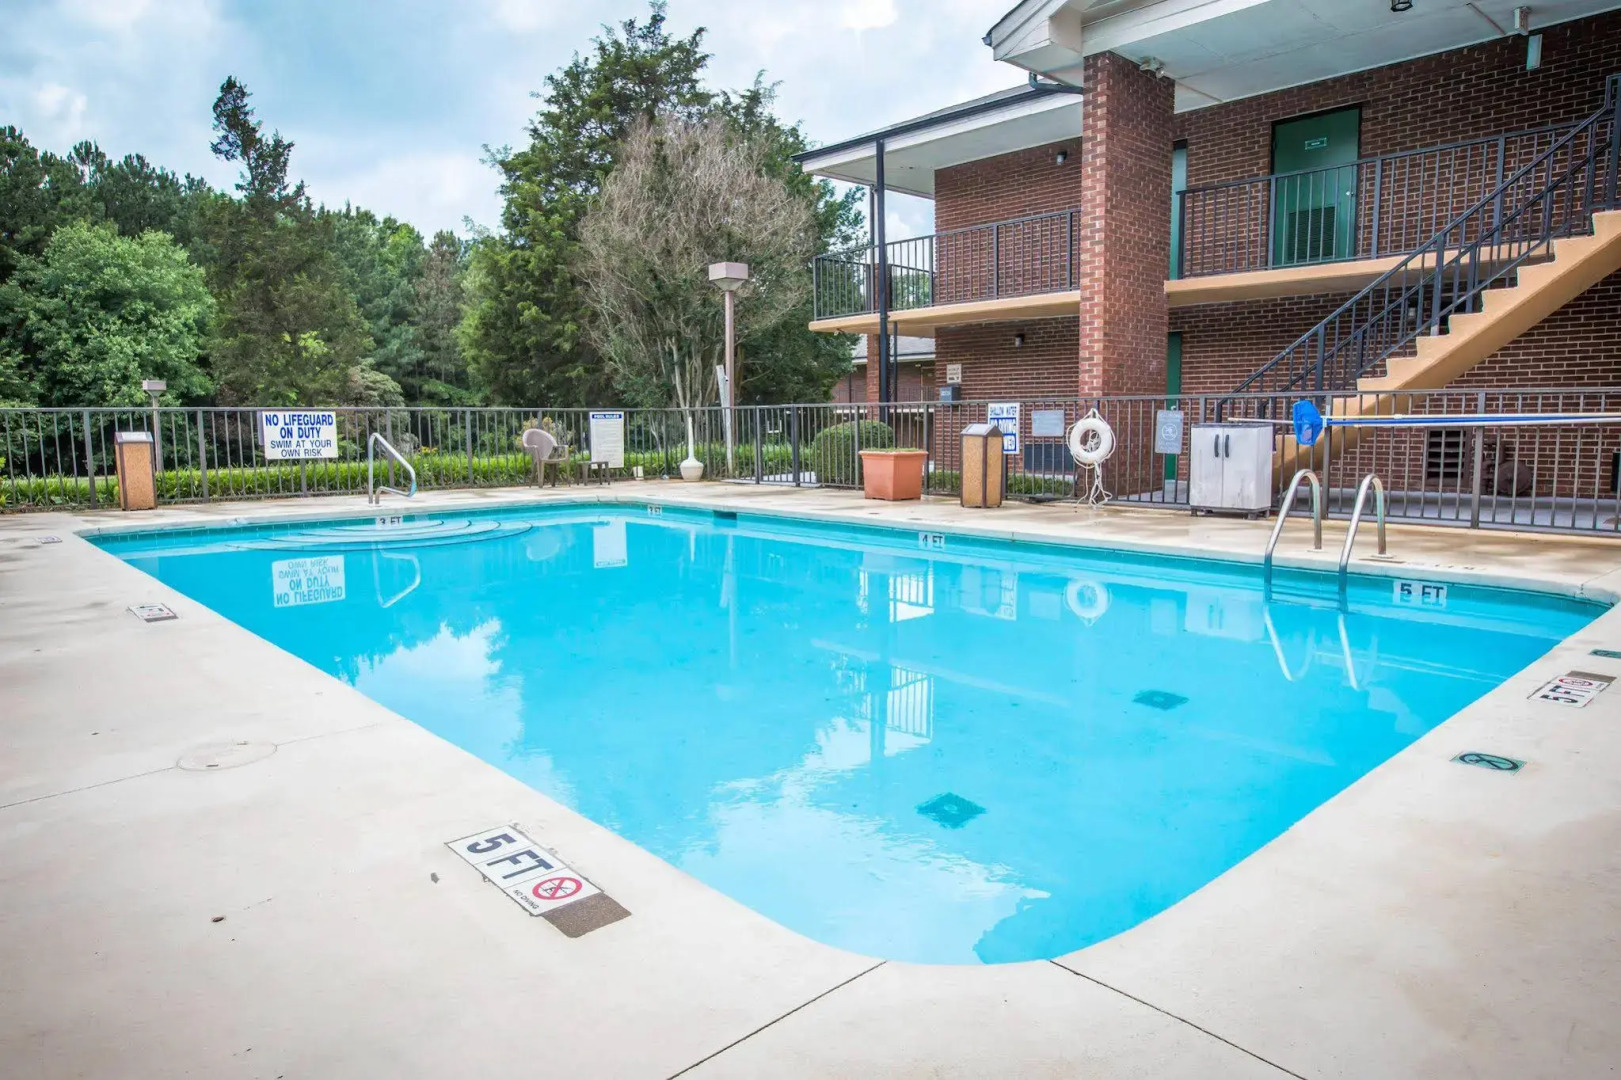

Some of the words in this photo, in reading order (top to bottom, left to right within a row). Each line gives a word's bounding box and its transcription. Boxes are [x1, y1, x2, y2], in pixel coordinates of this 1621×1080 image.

[265, 414, 279, 426] NO
[283, 414, 334, 426] LIFEGUARD
[280, 427, 293, 439] ON
[298, 427, 321, 439] DUTY
[270, 440, 292, 449] SWIM
[296, 440, 305, 448] AT
[310, 439, 332, 448] YOUR
[281, 449, 300, 458] OWN
[304, 448, 322, 457] RISK
[380, 517, 386, 525] 3
[390, 516, 401, 524] FT
[933, 535, 943, 544] FT
[1422, 585, 1444, 599] FT
[1549, 685, 1591, 697] FT
[1539, 694, 1578, 703] 5
[466, 833, 517, 854] 5
[486, 849, 554, 880] FT
[513, 889, 522, 899] NO
[520, 896, 540, 910] DIVING
